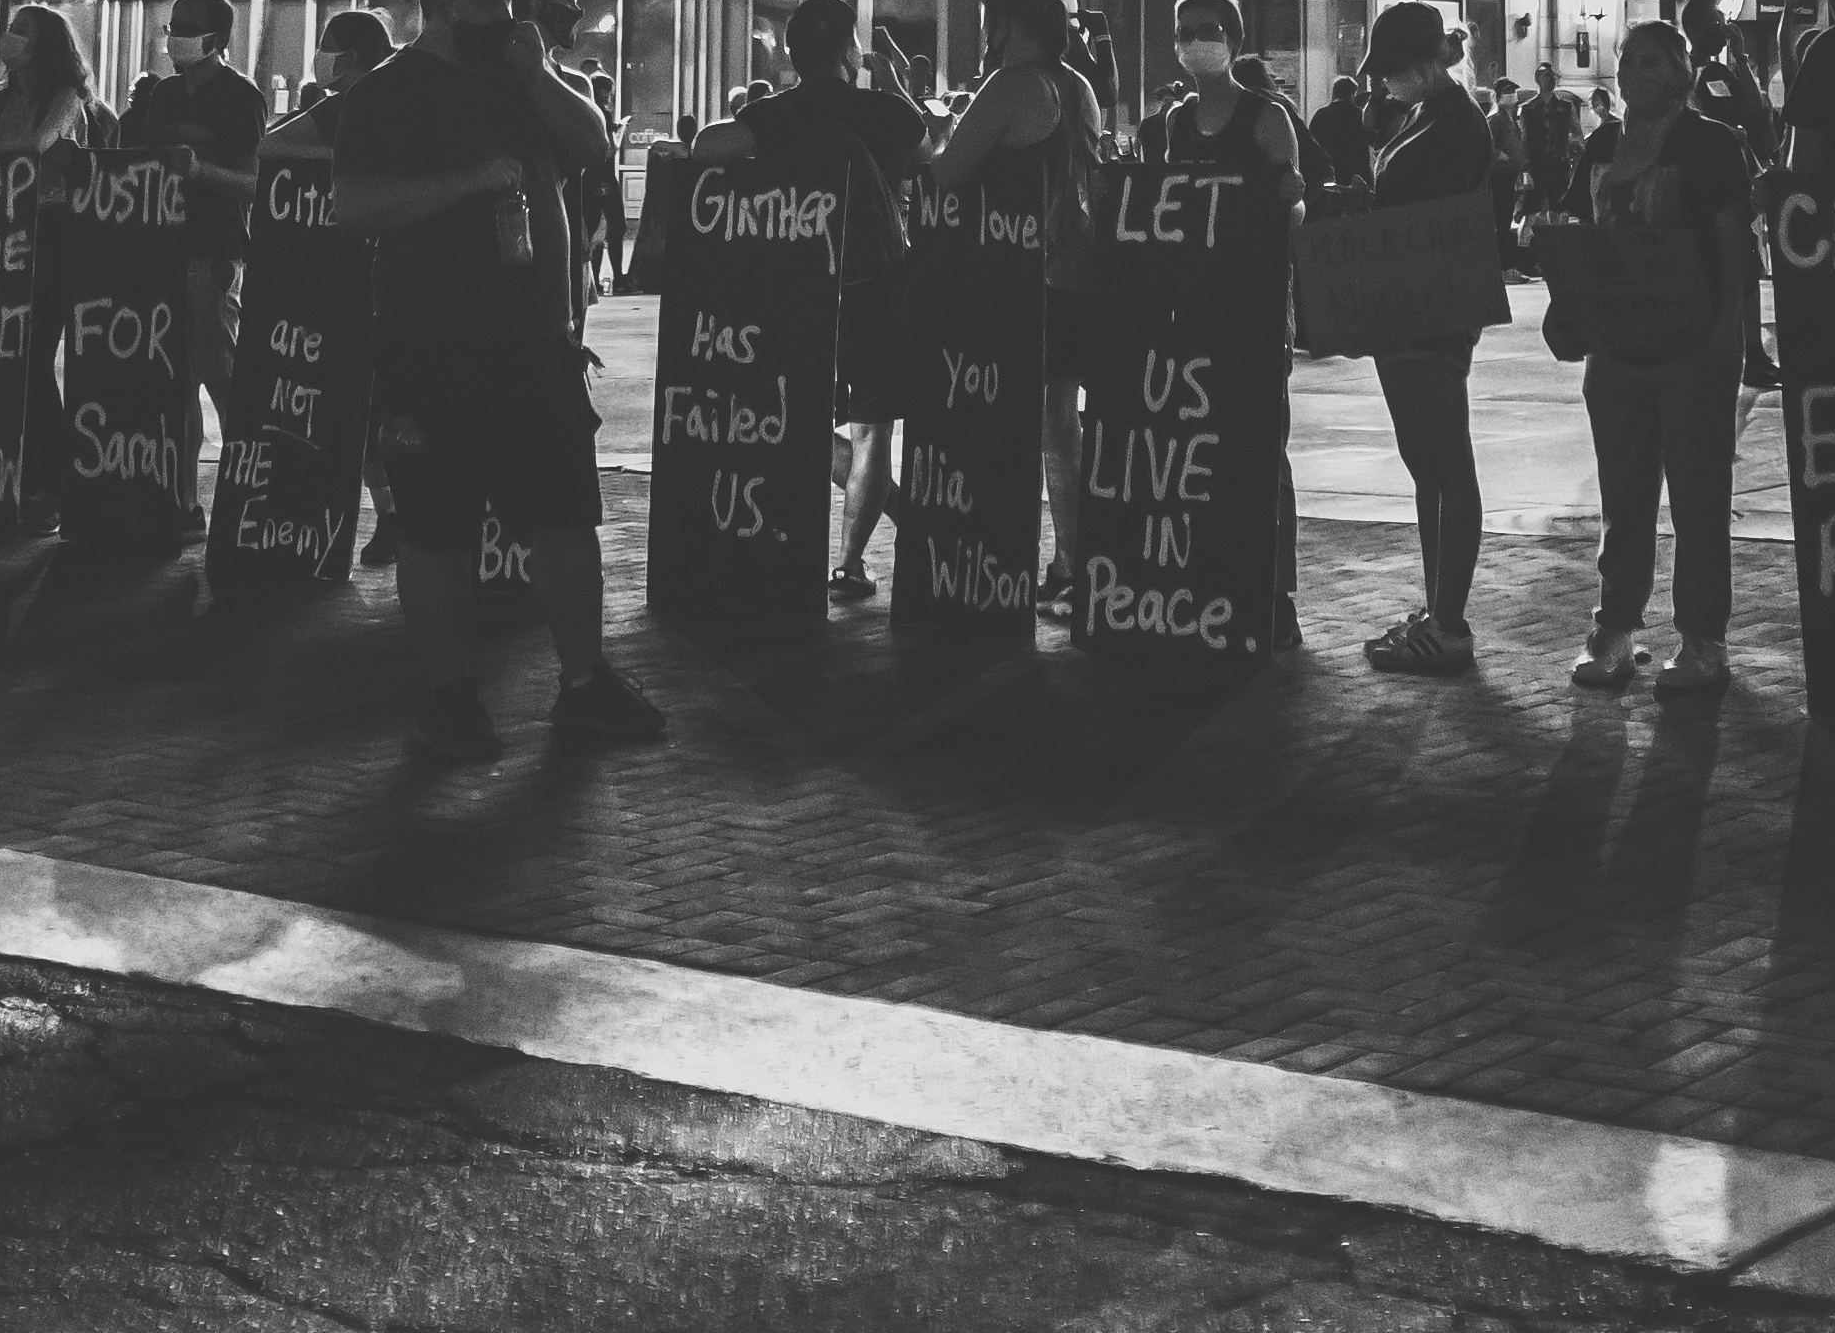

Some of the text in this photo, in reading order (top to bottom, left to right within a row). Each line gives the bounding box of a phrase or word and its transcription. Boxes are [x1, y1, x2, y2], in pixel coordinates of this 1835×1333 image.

[919, 184, 1041, 250] We love
[1114, 174, 1244, 249] LET
[73, 296, 175, 380] FOR
[269, 319, 324, 364] are
[691, 311, 761, 364] Has
[269, 376, 323, 438] NOT
[663, 374, 787, 445] Failed
[1142, 348, 1213, 421] US
[73, 400, 183, 512] Sarah
[223, 439, 272, 488] THE
[909, 443, 974, 516] Nia
[1088, 418, 1220, 503] LIVE
[235, 495, 345, 581] Enemy
[927, 536, 1032, 610] Wilson
[1141, 512, 1191, 568] IN
